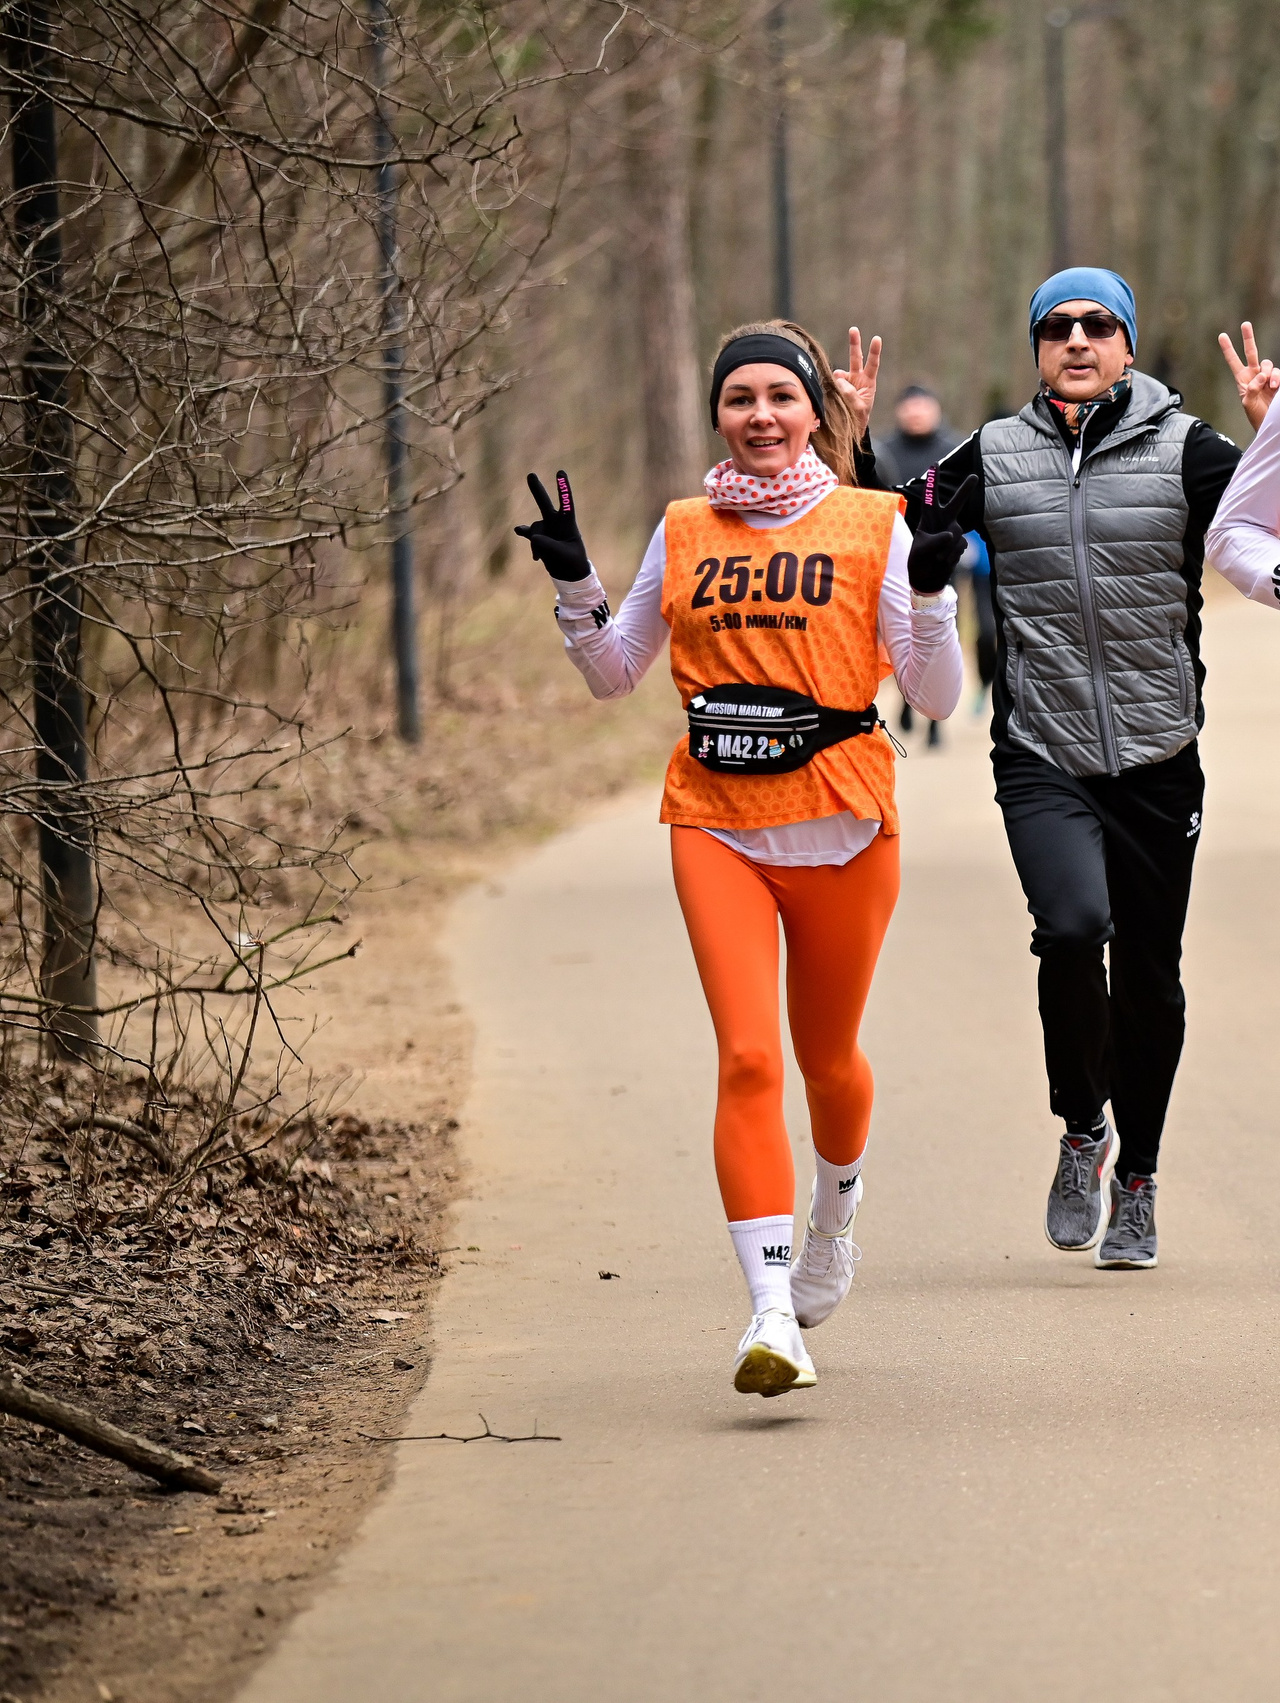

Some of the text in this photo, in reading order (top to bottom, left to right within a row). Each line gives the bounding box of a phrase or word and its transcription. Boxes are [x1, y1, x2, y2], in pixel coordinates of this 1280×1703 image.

[557, 477, 569, 493] JUST
[924, 488, 934, 506] JUST
[691, 551, 835, 610] 25:00
[709, 612, 743, 633] 5:00
[705, 702, 784, 717] MISSION MARATHON
[717, 734, 769, 759] M42.2
